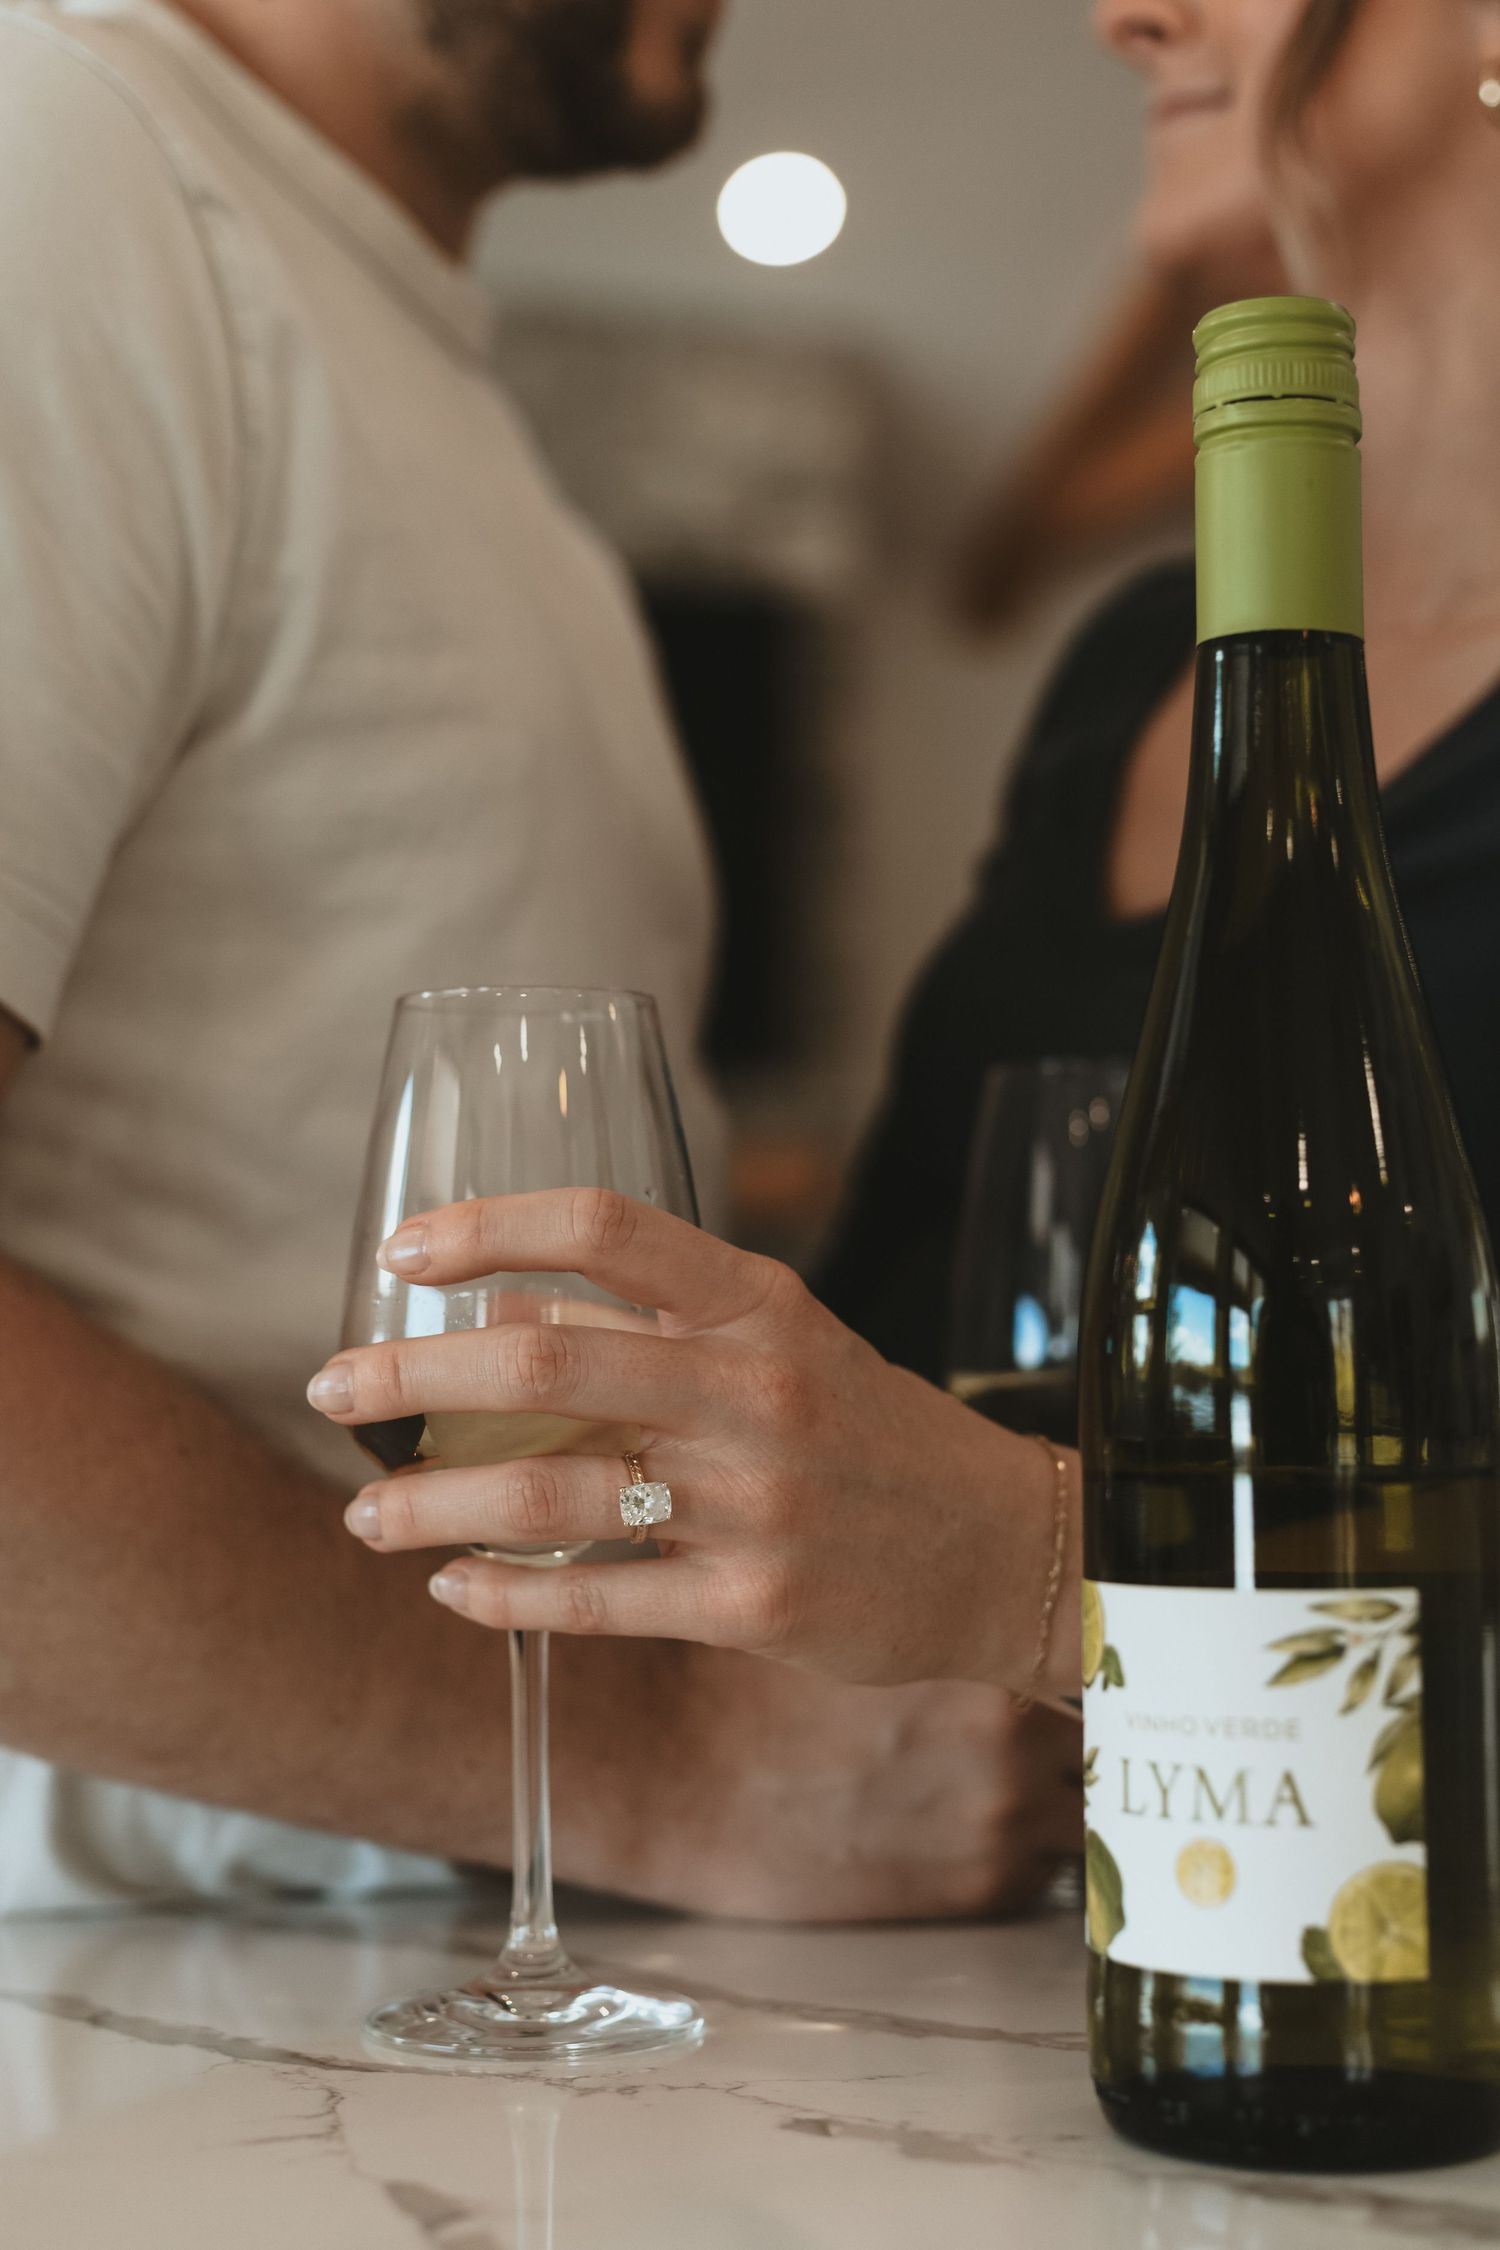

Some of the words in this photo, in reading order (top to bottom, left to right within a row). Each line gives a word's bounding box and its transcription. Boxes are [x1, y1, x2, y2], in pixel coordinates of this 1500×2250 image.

[1125, 1711, 1196, 1735] VINHO
[1205, 1715, 1300, 1742] VERDE
[1120, 1757, 1315, 1828] LYMA
